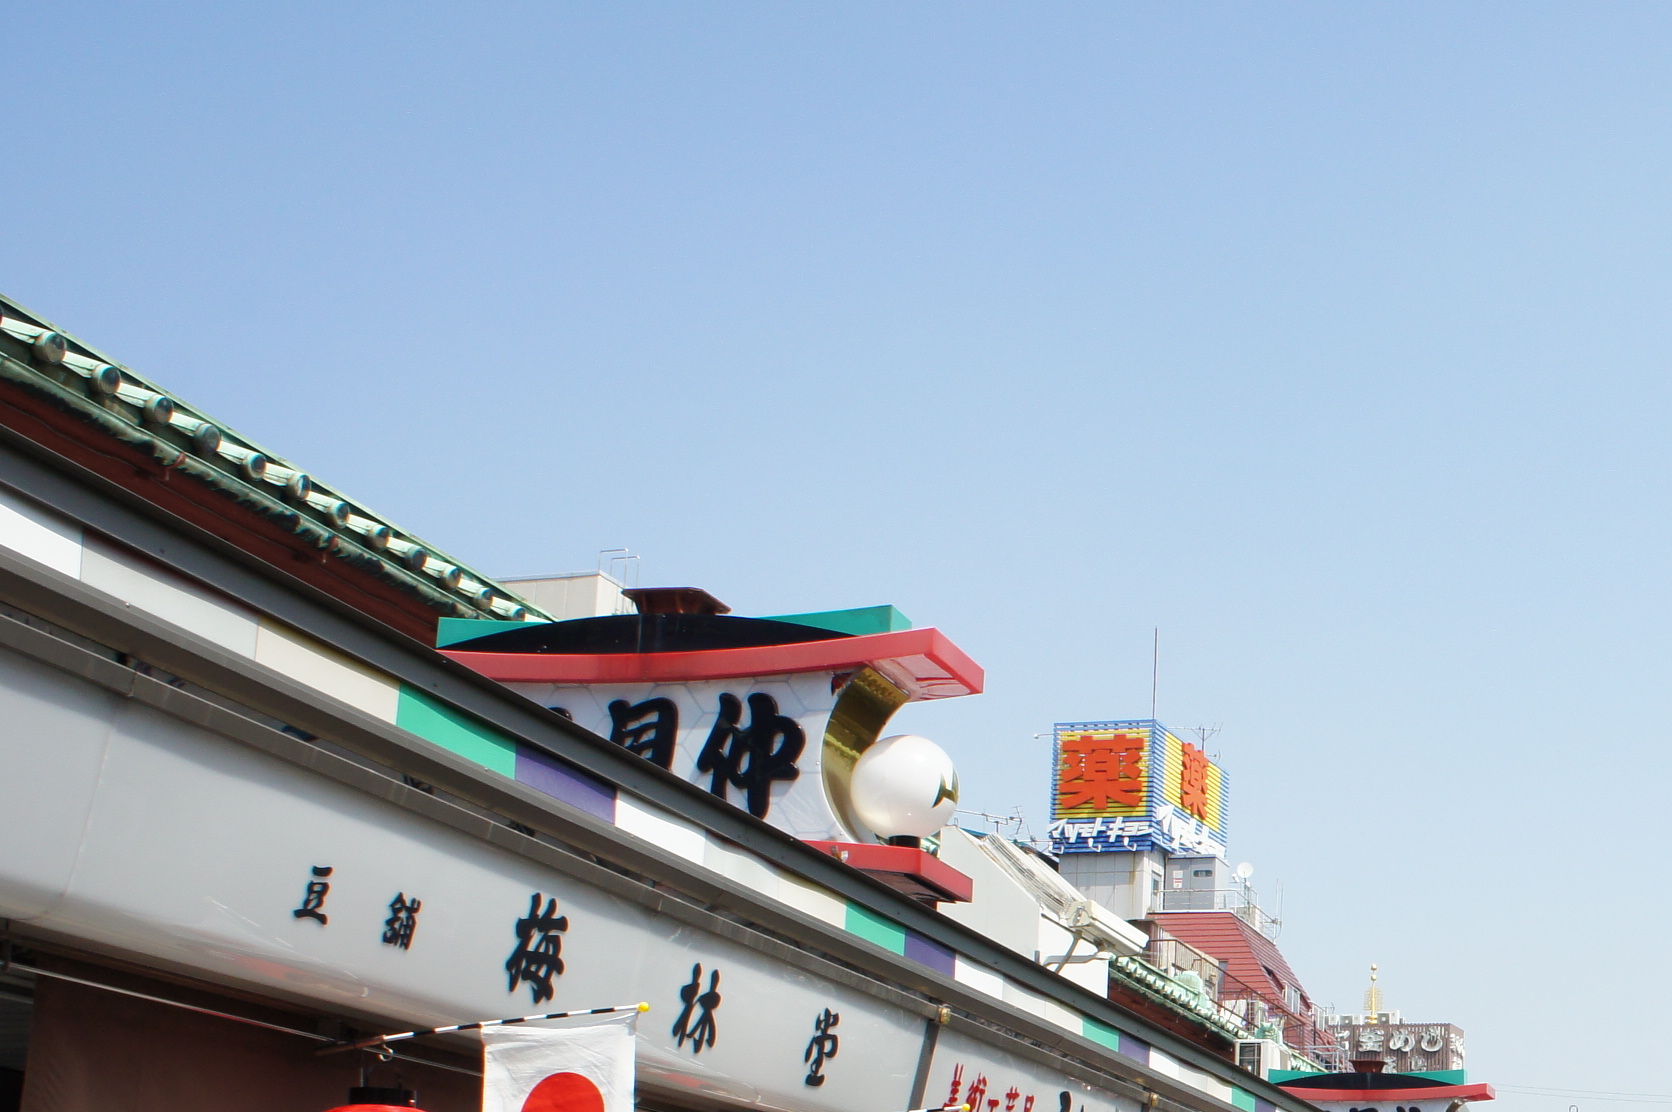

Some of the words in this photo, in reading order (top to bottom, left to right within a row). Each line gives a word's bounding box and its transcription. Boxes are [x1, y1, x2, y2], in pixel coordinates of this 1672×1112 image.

[1058, 734, 1144, 810] 薬
[1181, 742, 1208, 820] 薬
[1048, 817, 1152, 843] マツモトキヨシ
[506, 892, 840, 1088] 梅林堂
